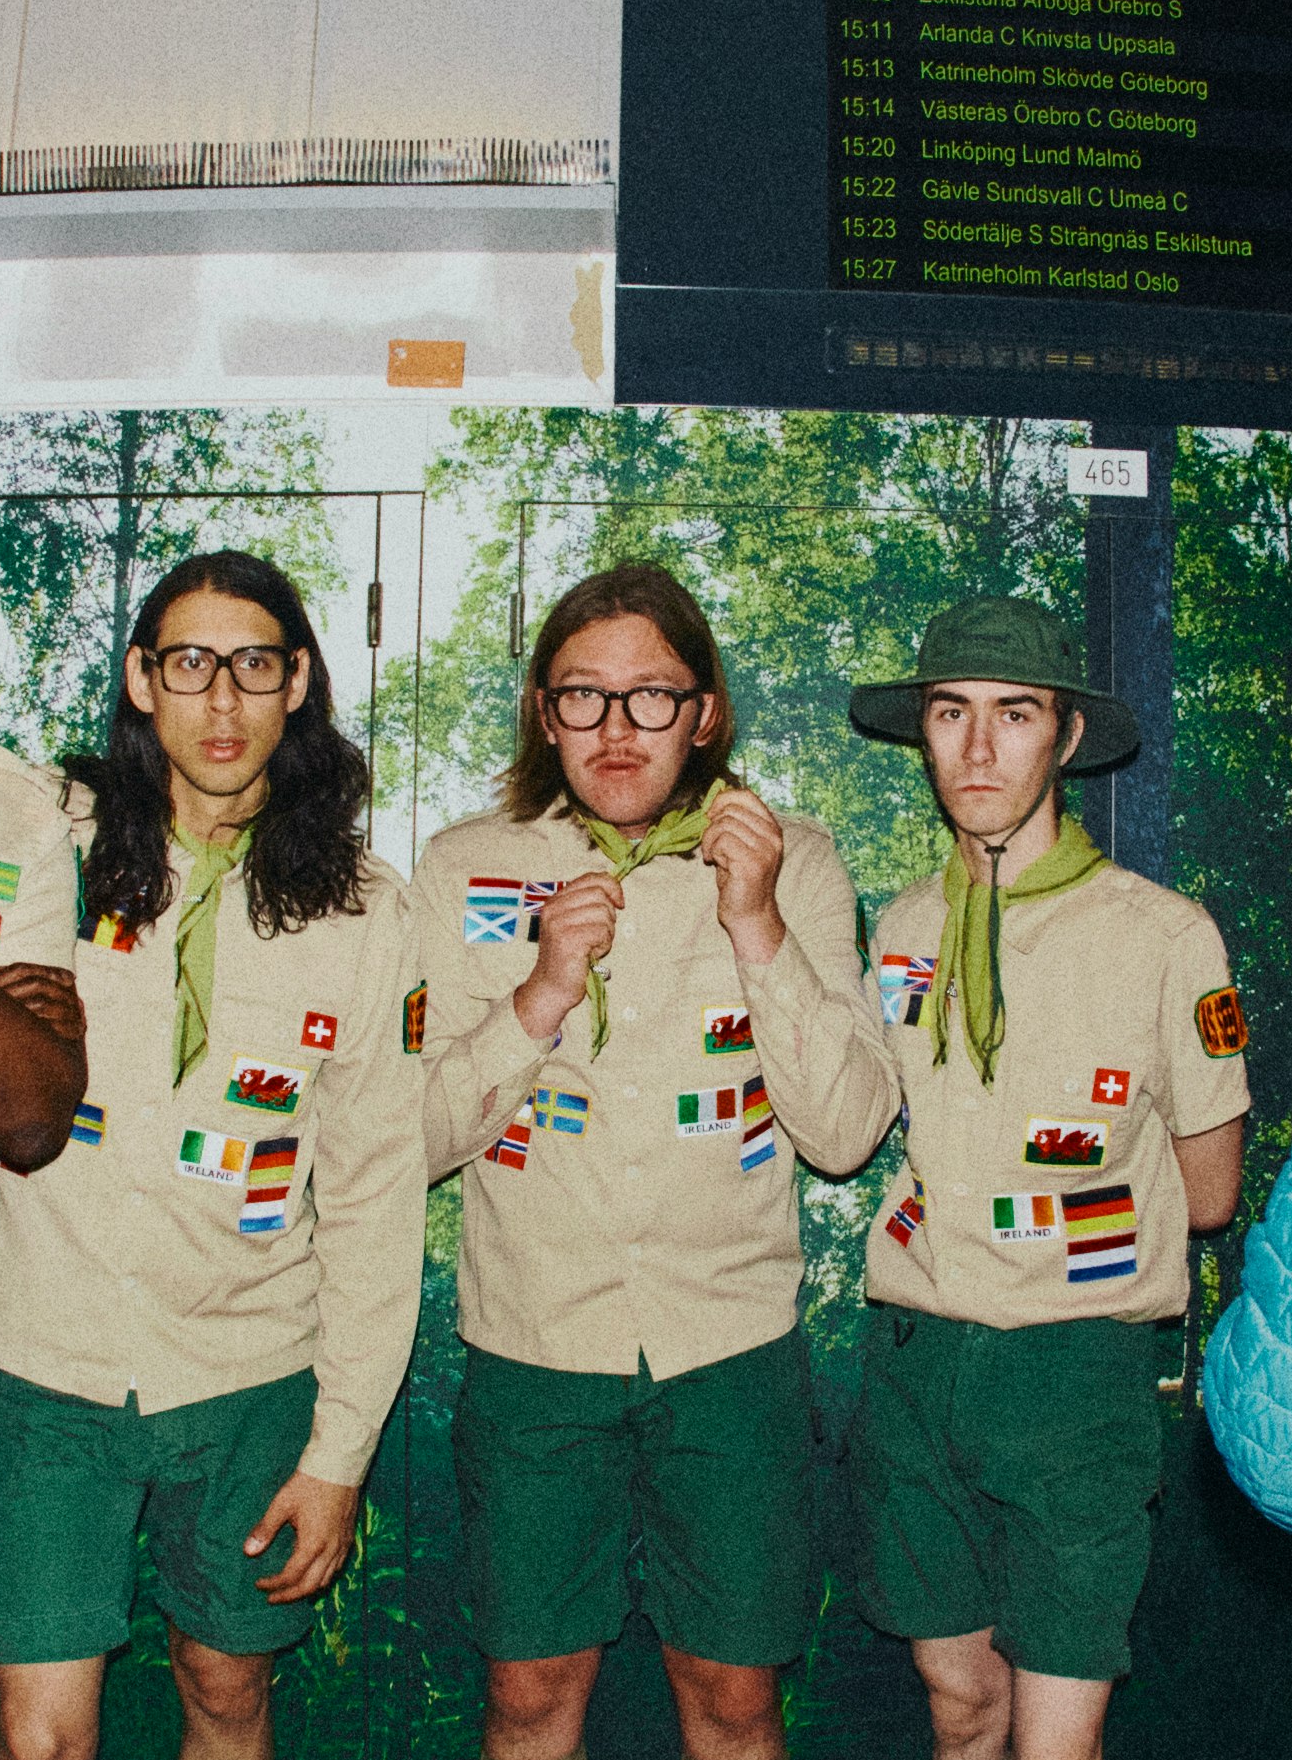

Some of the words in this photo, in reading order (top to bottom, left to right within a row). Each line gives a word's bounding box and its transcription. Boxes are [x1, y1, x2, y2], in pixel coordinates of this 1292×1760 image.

[1169, 0, 1182, 18] S
[841, 20, 891, 39] 15:11
[919, 23, 994, 44] Arlanda
[1000, 26, 1015, 46] C
[1022, 28, 1091, 50] Knivsta
[1098, 33, 1175, 56] Uppsala
[842, 58, 894, 78] 15:13
[920, 61, 1036, 84] Katrineholm
[1043, 66, 1114, 89] Skövde
[1120, 71, 1208, 100] Göteborg
[842, 97, 894, 116] 15:14
[921, 100, 1007, 122] Västerås
[1014, 101, 1081, 126] Örebro
[1087, 107, 1102, 128] C
[1108, 109, 1197, 138] Göteborg
[842, 137, 896, 157] 15:20
[922, 140, 1016, 167] Linköping
[1022, 144, 1070, 165] Lund
[1077, 147, 1141, 169] Malmö
[842, 176, 896, 198] 15:22
[922, 179, 980, 201] Gävle
[987, 181, 1081, 205] Sundsvall
[1088, 187, 1103, 207] C
[1110, 188, 1166, 211] Umeå
[1173, 191, 1188, 212] C
[842, 217, 896, 239] 15:23
[923, 219, 1022, 248] Södertälje
[1029, 224, 1043, 245] S
[1050, 225, 1149, 253] Strängnäs
[1155, 231, 1252, 256] Eskilstuna
[843, 259, 896, 279] 15:27
[924, 261, 1041, 284] Katrineholm
[1048, 267, 1127, 290] Karlstad
[1134, 270, 1179, 292] Oslo
[1085, 458, 1131, 487] 465
[684, 1121, 732, 1135] IRELAND
[184, 1164, 234, 1182] IRELAND
[999, 1227, 1052, 1239] IRELAND
